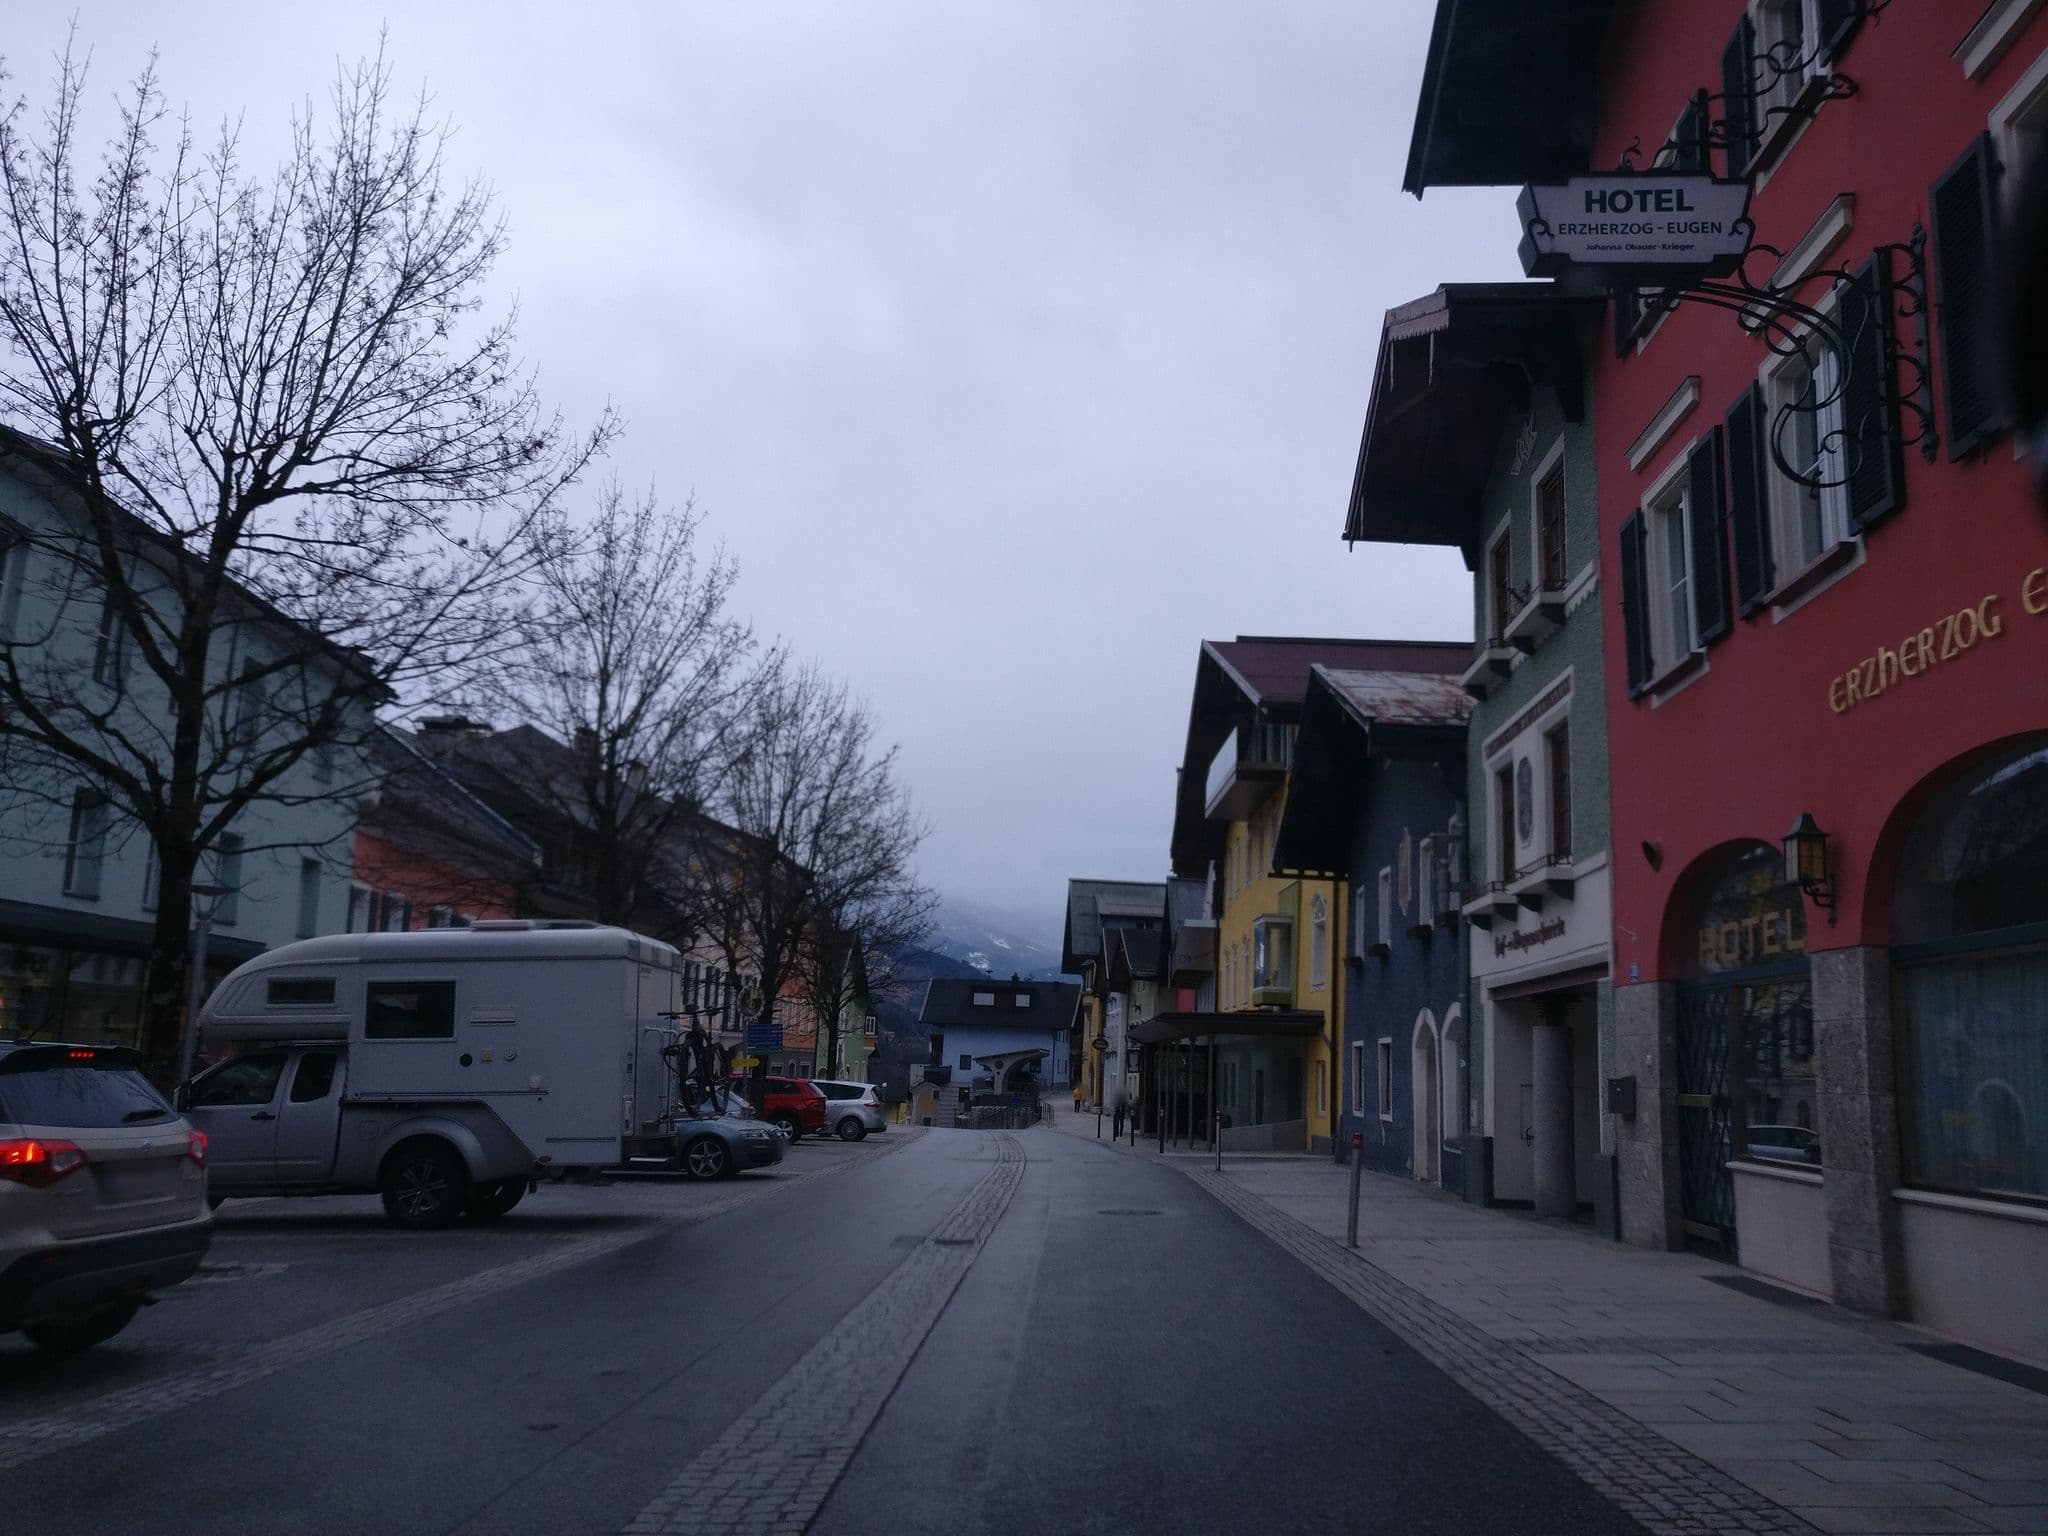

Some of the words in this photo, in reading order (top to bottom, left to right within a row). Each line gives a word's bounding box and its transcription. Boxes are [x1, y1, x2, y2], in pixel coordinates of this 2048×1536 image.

[1584, 189, 1694, 213] HOTEL
[1585, 242, 1622, 251] Johanna
[1697, 908, 1809, 968] HOTEL
